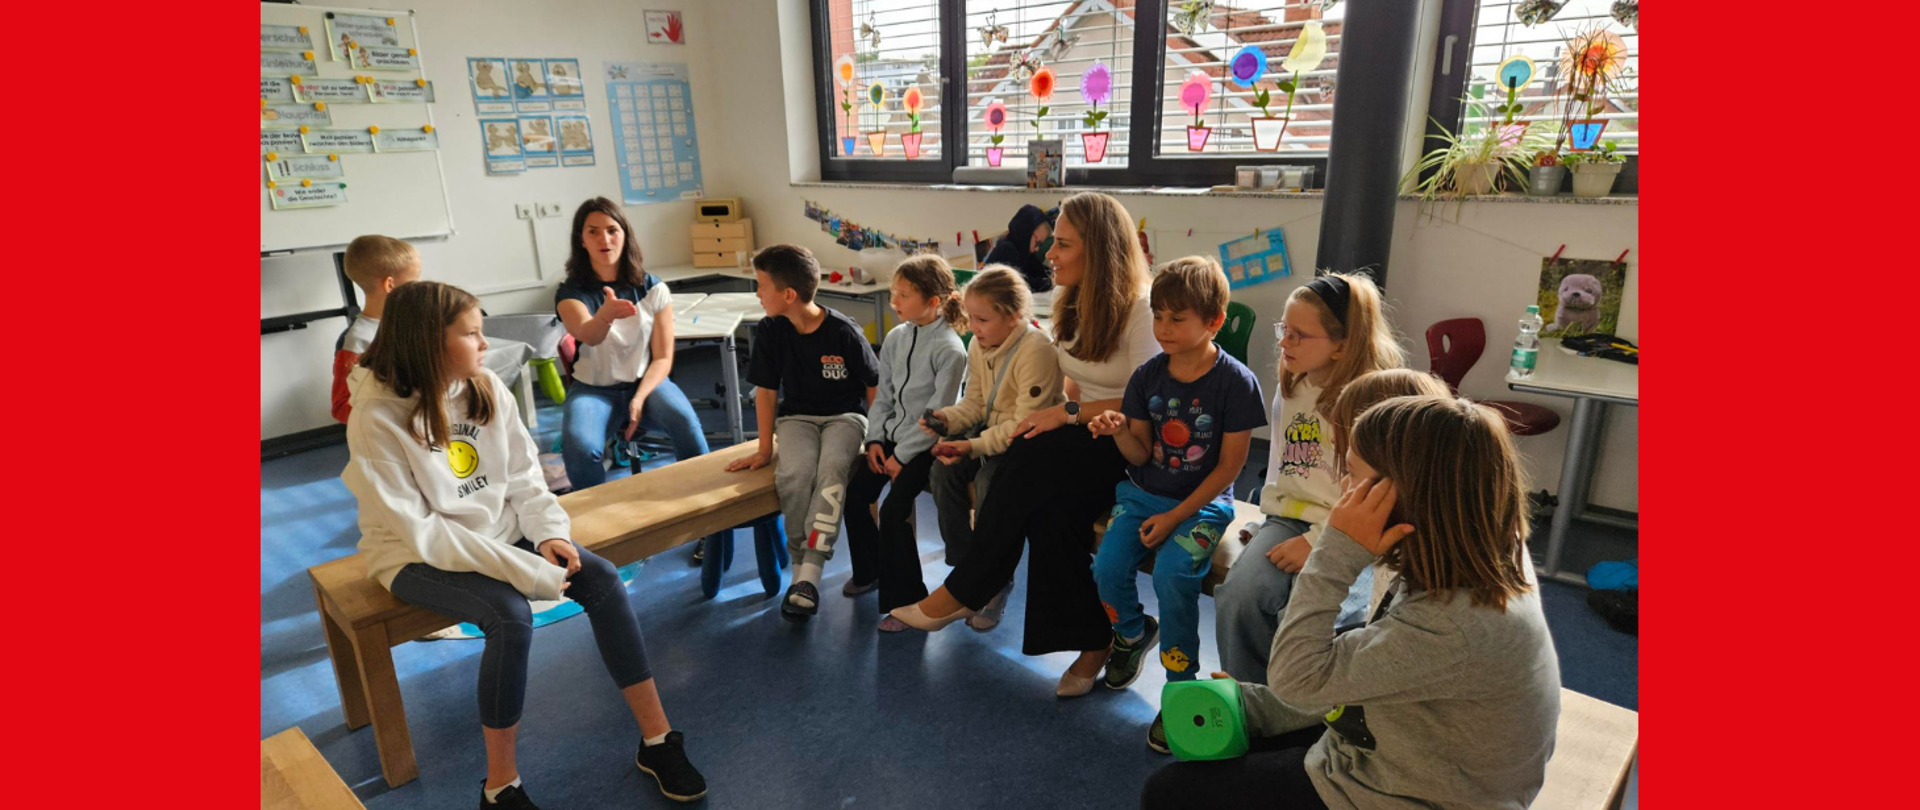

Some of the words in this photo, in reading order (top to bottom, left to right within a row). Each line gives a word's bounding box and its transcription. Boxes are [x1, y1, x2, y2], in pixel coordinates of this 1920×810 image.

[277, 109, 326, 121] Hauptteil
[292, 161, 330, 172] Schluss
[457, 474, 489, 498] SMILEY
[807, 483, 844, 553] FILA
